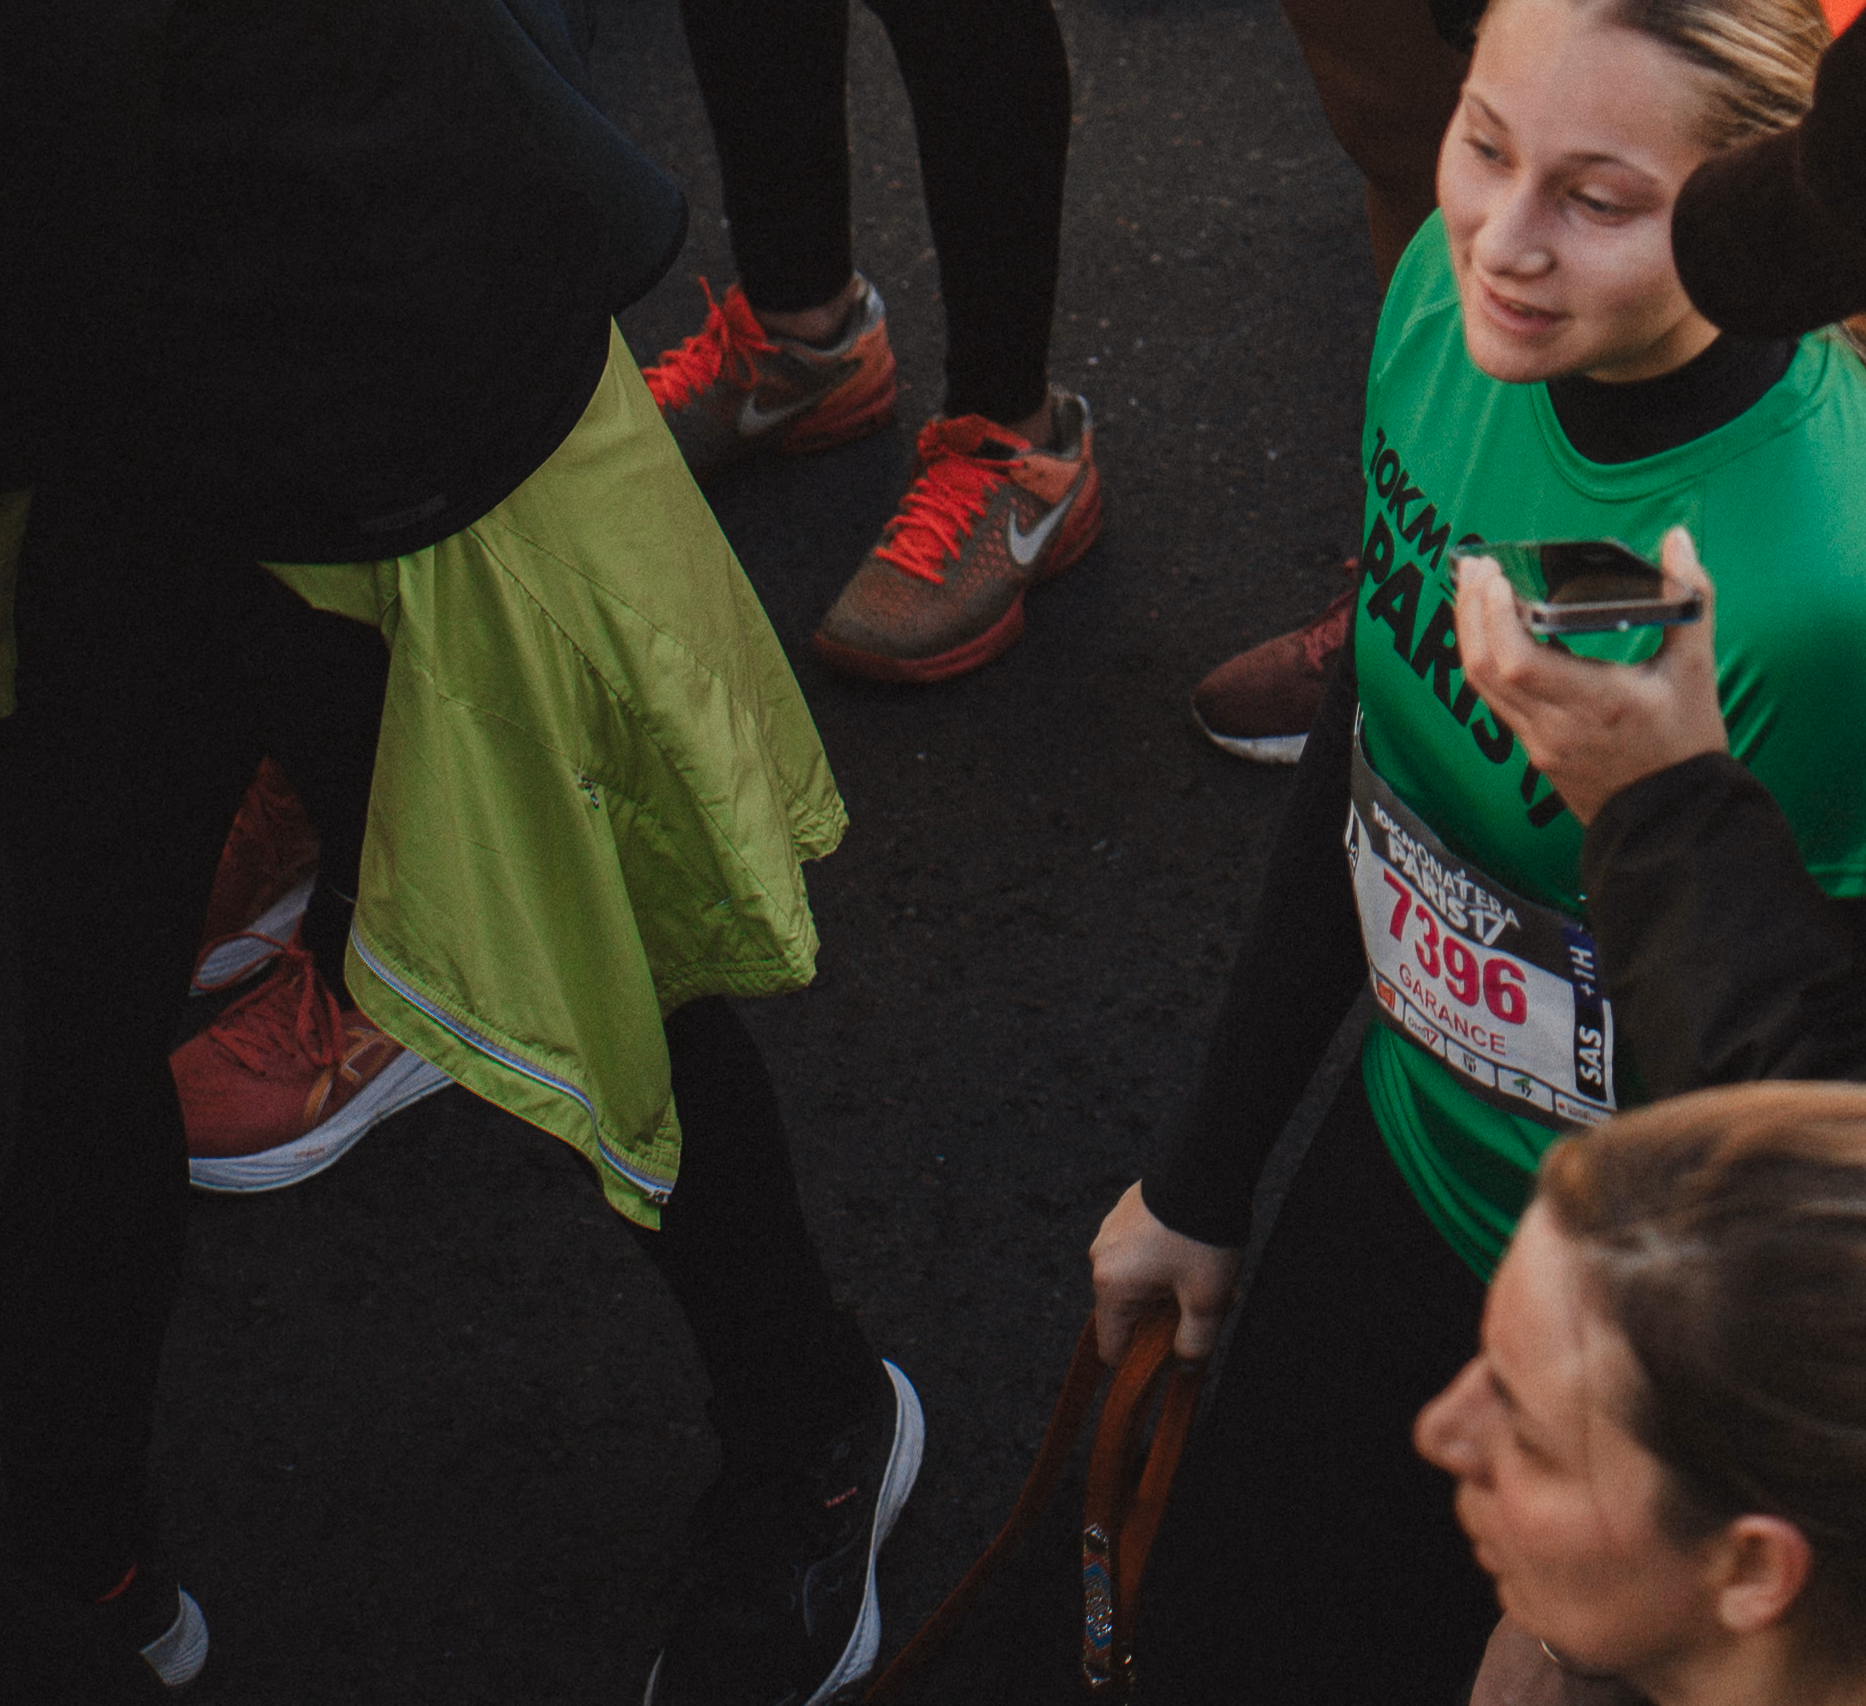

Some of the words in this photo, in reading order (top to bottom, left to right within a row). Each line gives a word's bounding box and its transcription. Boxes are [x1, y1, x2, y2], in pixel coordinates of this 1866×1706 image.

[1383, 866, 1528, 1026] 7396
[1399, 962, 1508, 1056] GARANCE
[1578, 1024, 1605, 1086] SAS
